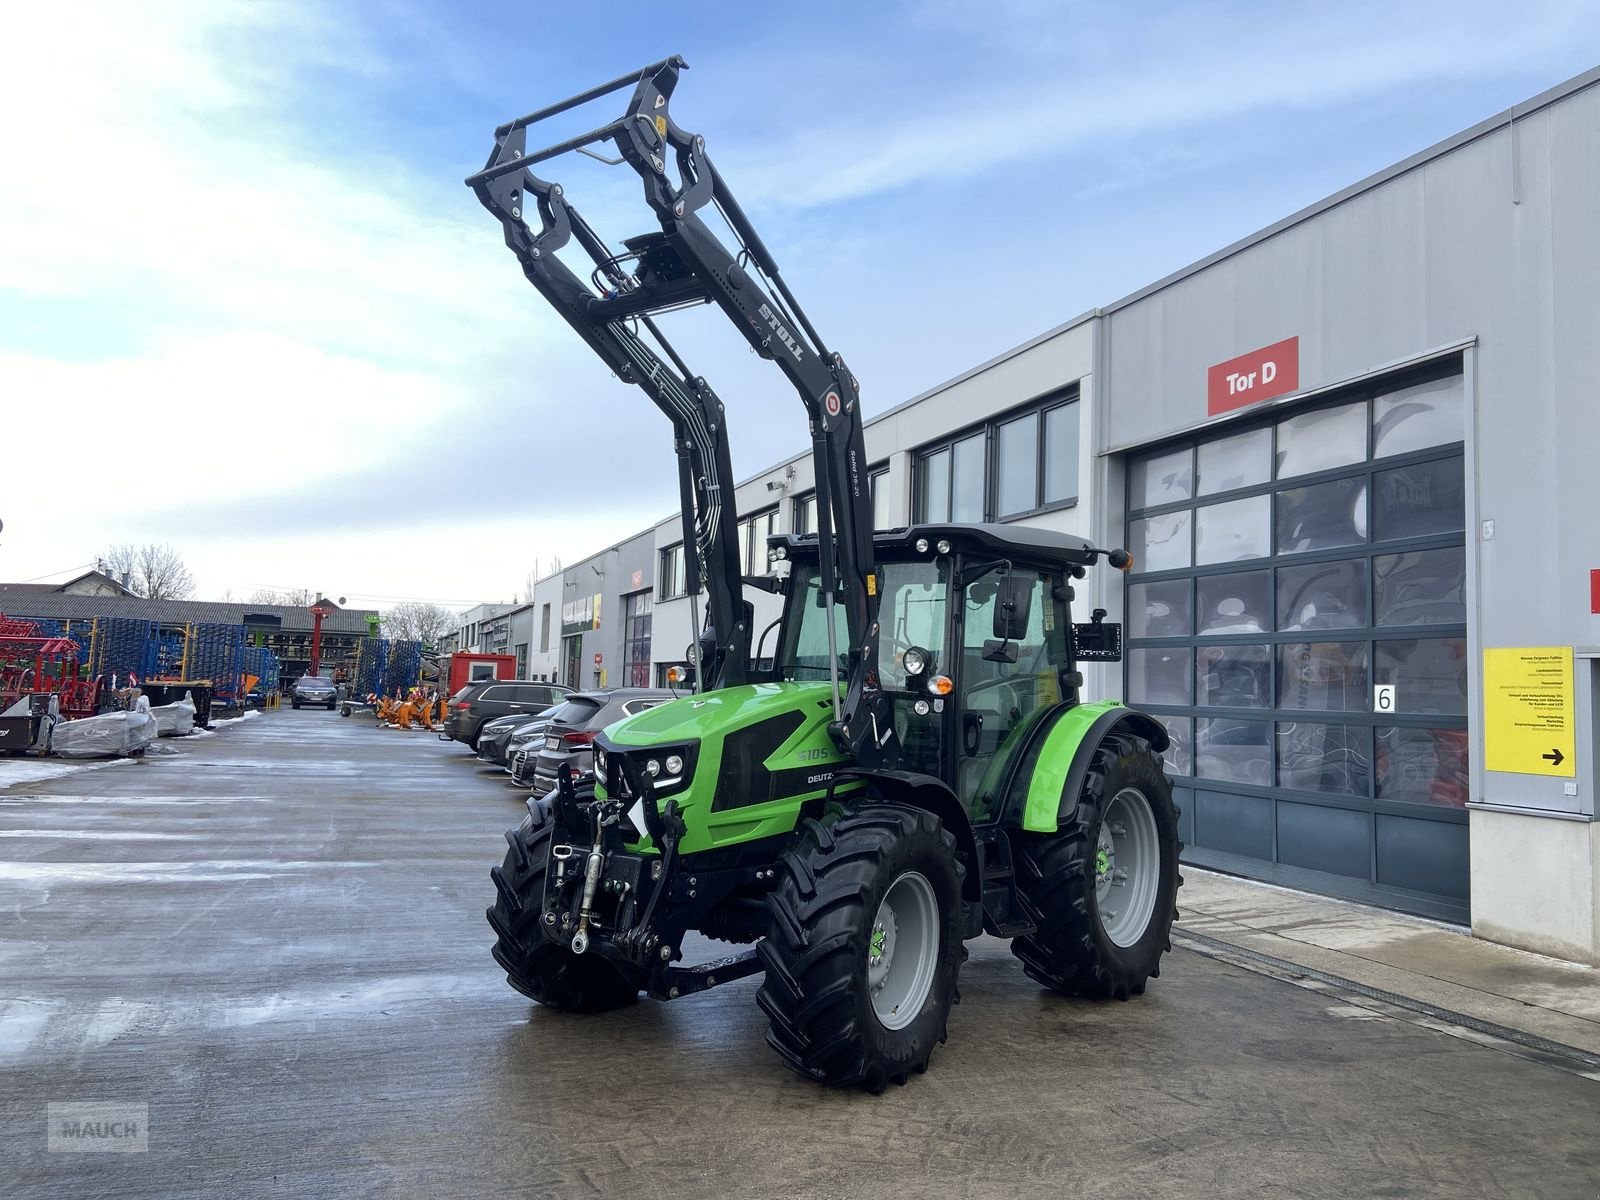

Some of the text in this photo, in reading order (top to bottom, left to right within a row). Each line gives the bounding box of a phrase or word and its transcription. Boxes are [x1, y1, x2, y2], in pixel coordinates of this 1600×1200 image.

[758, 303, 804, 362] STOLL
[1226, 361, 1277, 395] Tor D
[1379, 688, 1390, 709] 6
